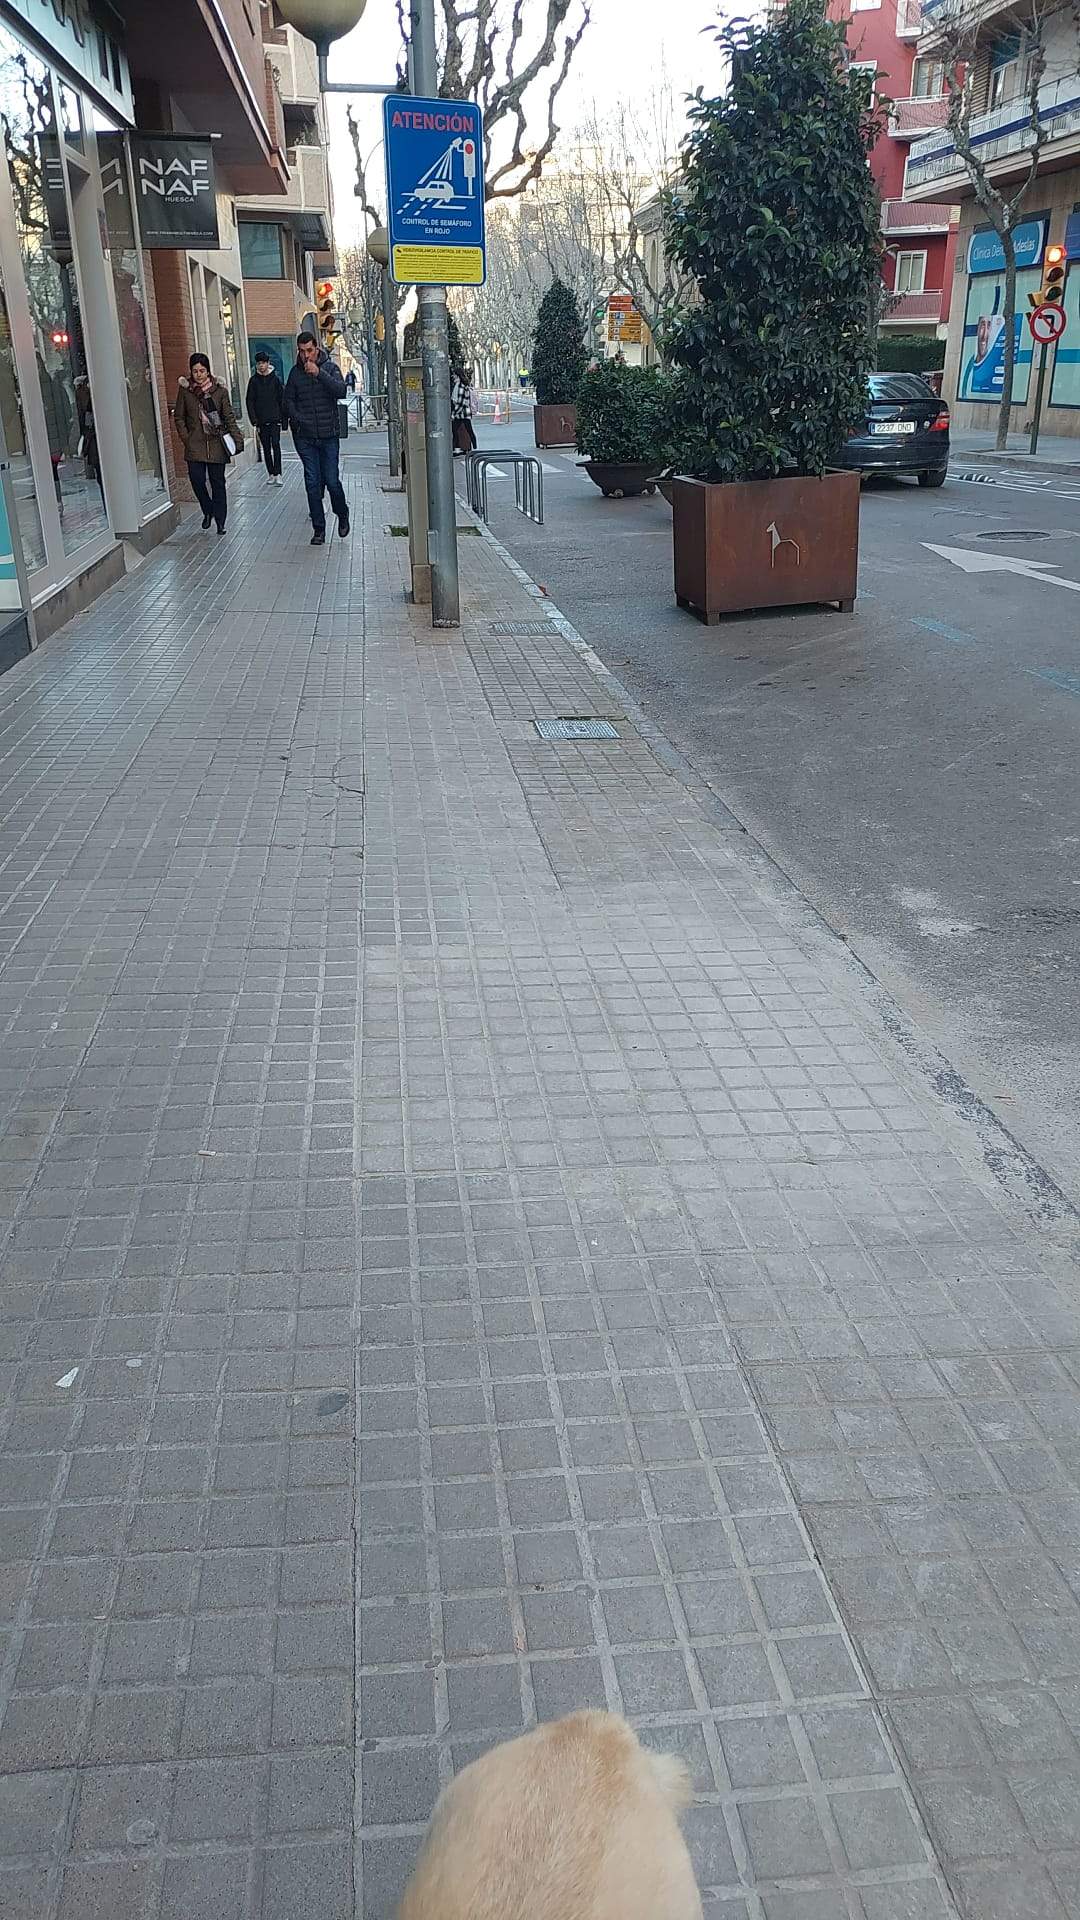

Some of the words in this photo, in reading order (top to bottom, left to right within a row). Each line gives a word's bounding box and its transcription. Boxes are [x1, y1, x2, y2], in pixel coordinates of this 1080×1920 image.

[392, 111, 474, 133] ATENCIÓN
[139, 158, 208, 176] NAF
[141, 178, 210, 196] NAF
[402, 218, 430, 226] CONTROL
[440, 219, 472, 227] SEMÁFORO
